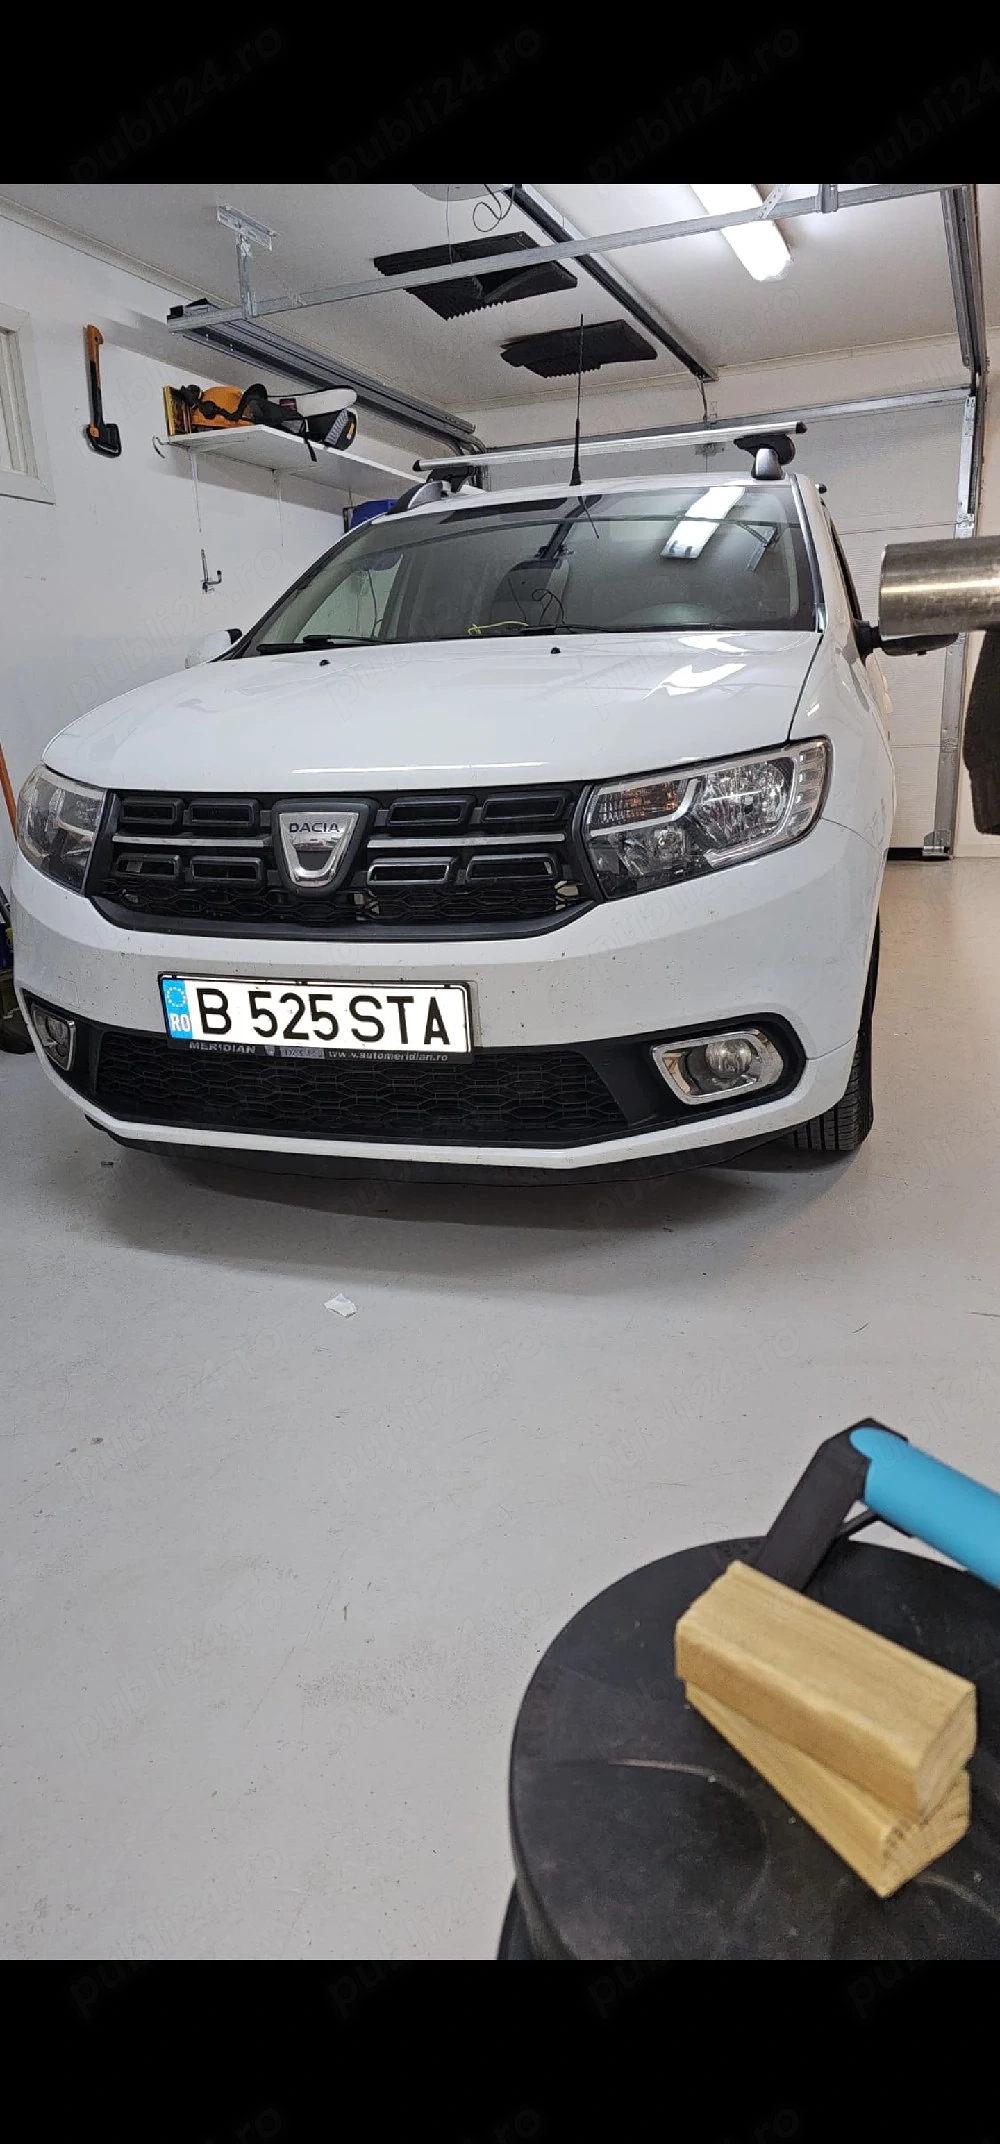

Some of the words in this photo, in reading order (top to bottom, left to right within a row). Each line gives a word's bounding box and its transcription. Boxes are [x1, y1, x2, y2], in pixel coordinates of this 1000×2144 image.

[289, 822, 340, 833] DACIA
[168, 1013, 191, 1033] RO
[196, 988, 232, 1035] B
[248, 990, 339, 1041] 525
[348, 994, 451, 1045] STA
[189, 1041, 256, 1054] MERIDIAN
